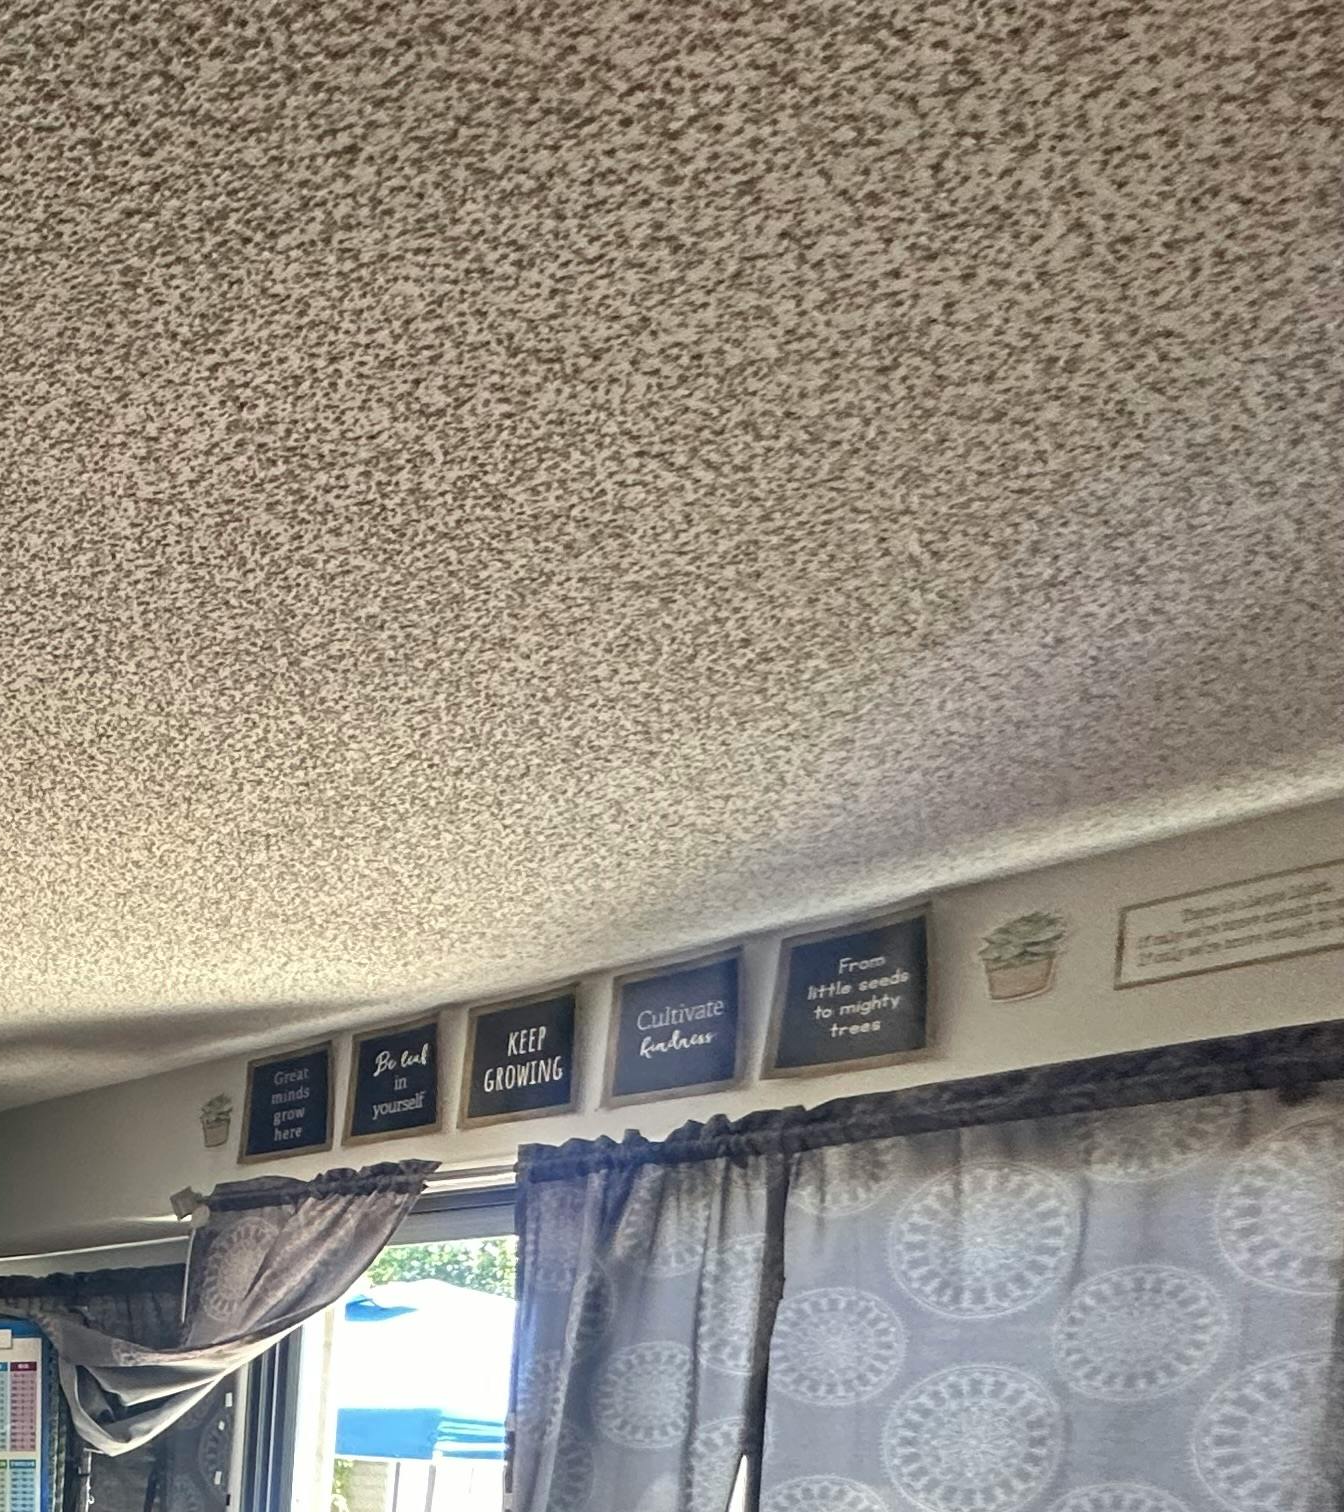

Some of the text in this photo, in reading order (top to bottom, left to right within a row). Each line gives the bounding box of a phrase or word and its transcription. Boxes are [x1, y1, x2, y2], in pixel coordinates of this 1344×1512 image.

[838, 954, 887, 975] From
[807, 969, 909, 1000] little seeds
[637, 999, 726, 1032] Cultivate
[813, 994, 901, 1020] to mighty
[507, 1026, 546, 1057] KEEP
[831, 1019, 881, 1038] trees
[640, 1030, 718, 1059] kindness
[273, 1067, 309, 1087] Great
[373, 1051, 397, 1078] Be
[483, 1057, 563, 1093] GROWING
[271, 1086, 310, 1105] minds
[394, 1076, 408, 1091] in
[272, 1106, 305, 1126] grow
[372, 1091, 427, 1121] yourself
[274, 1125, 303, 1141] here
